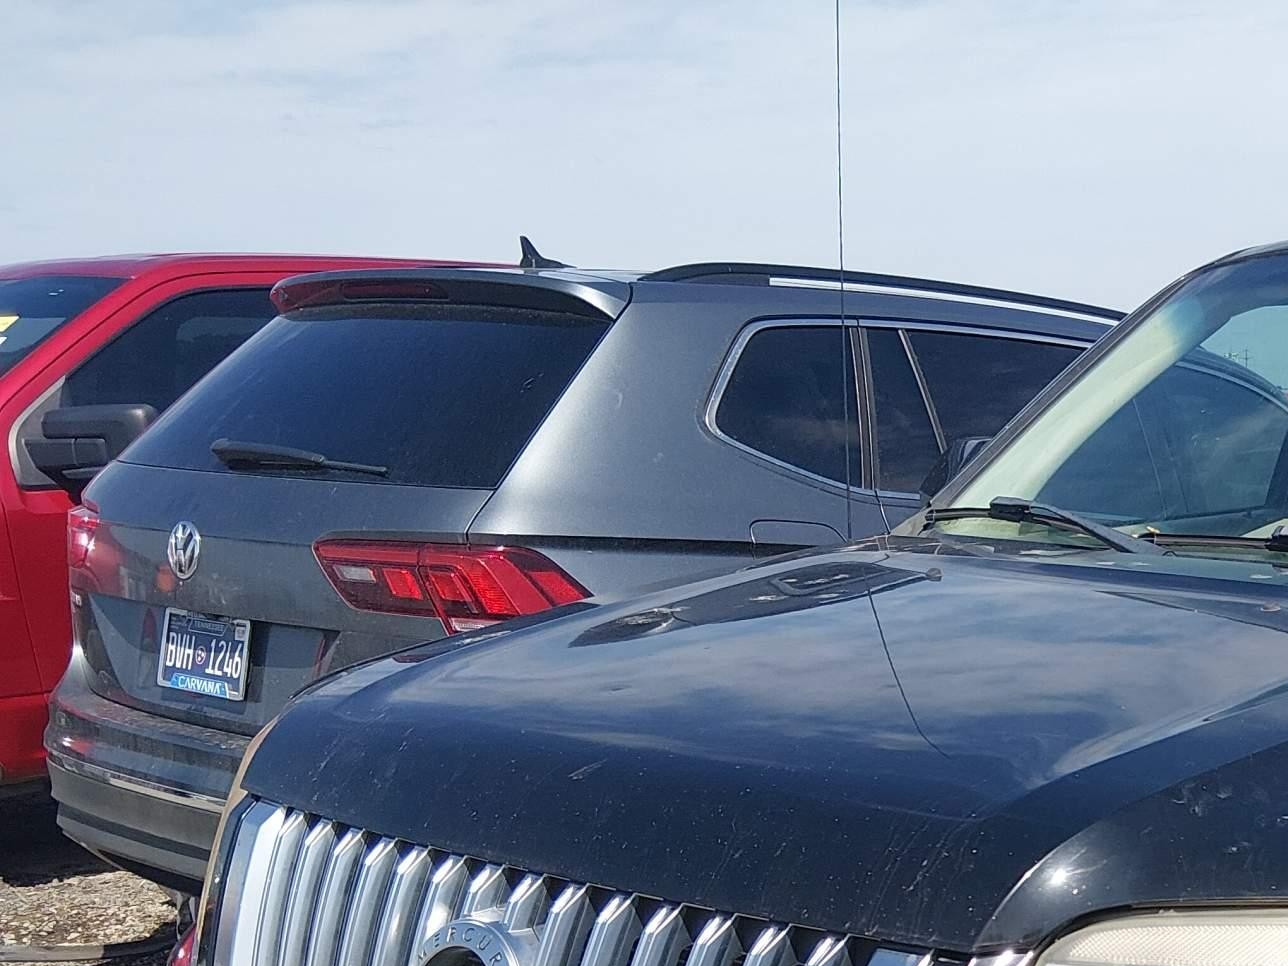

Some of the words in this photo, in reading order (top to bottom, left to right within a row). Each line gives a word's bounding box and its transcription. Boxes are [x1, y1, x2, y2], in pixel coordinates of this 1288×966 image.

[166, 632, 195, 670] BVH
[205, 639, 242, 678] 1246
[178, 676, 222, 695] CARVANA
